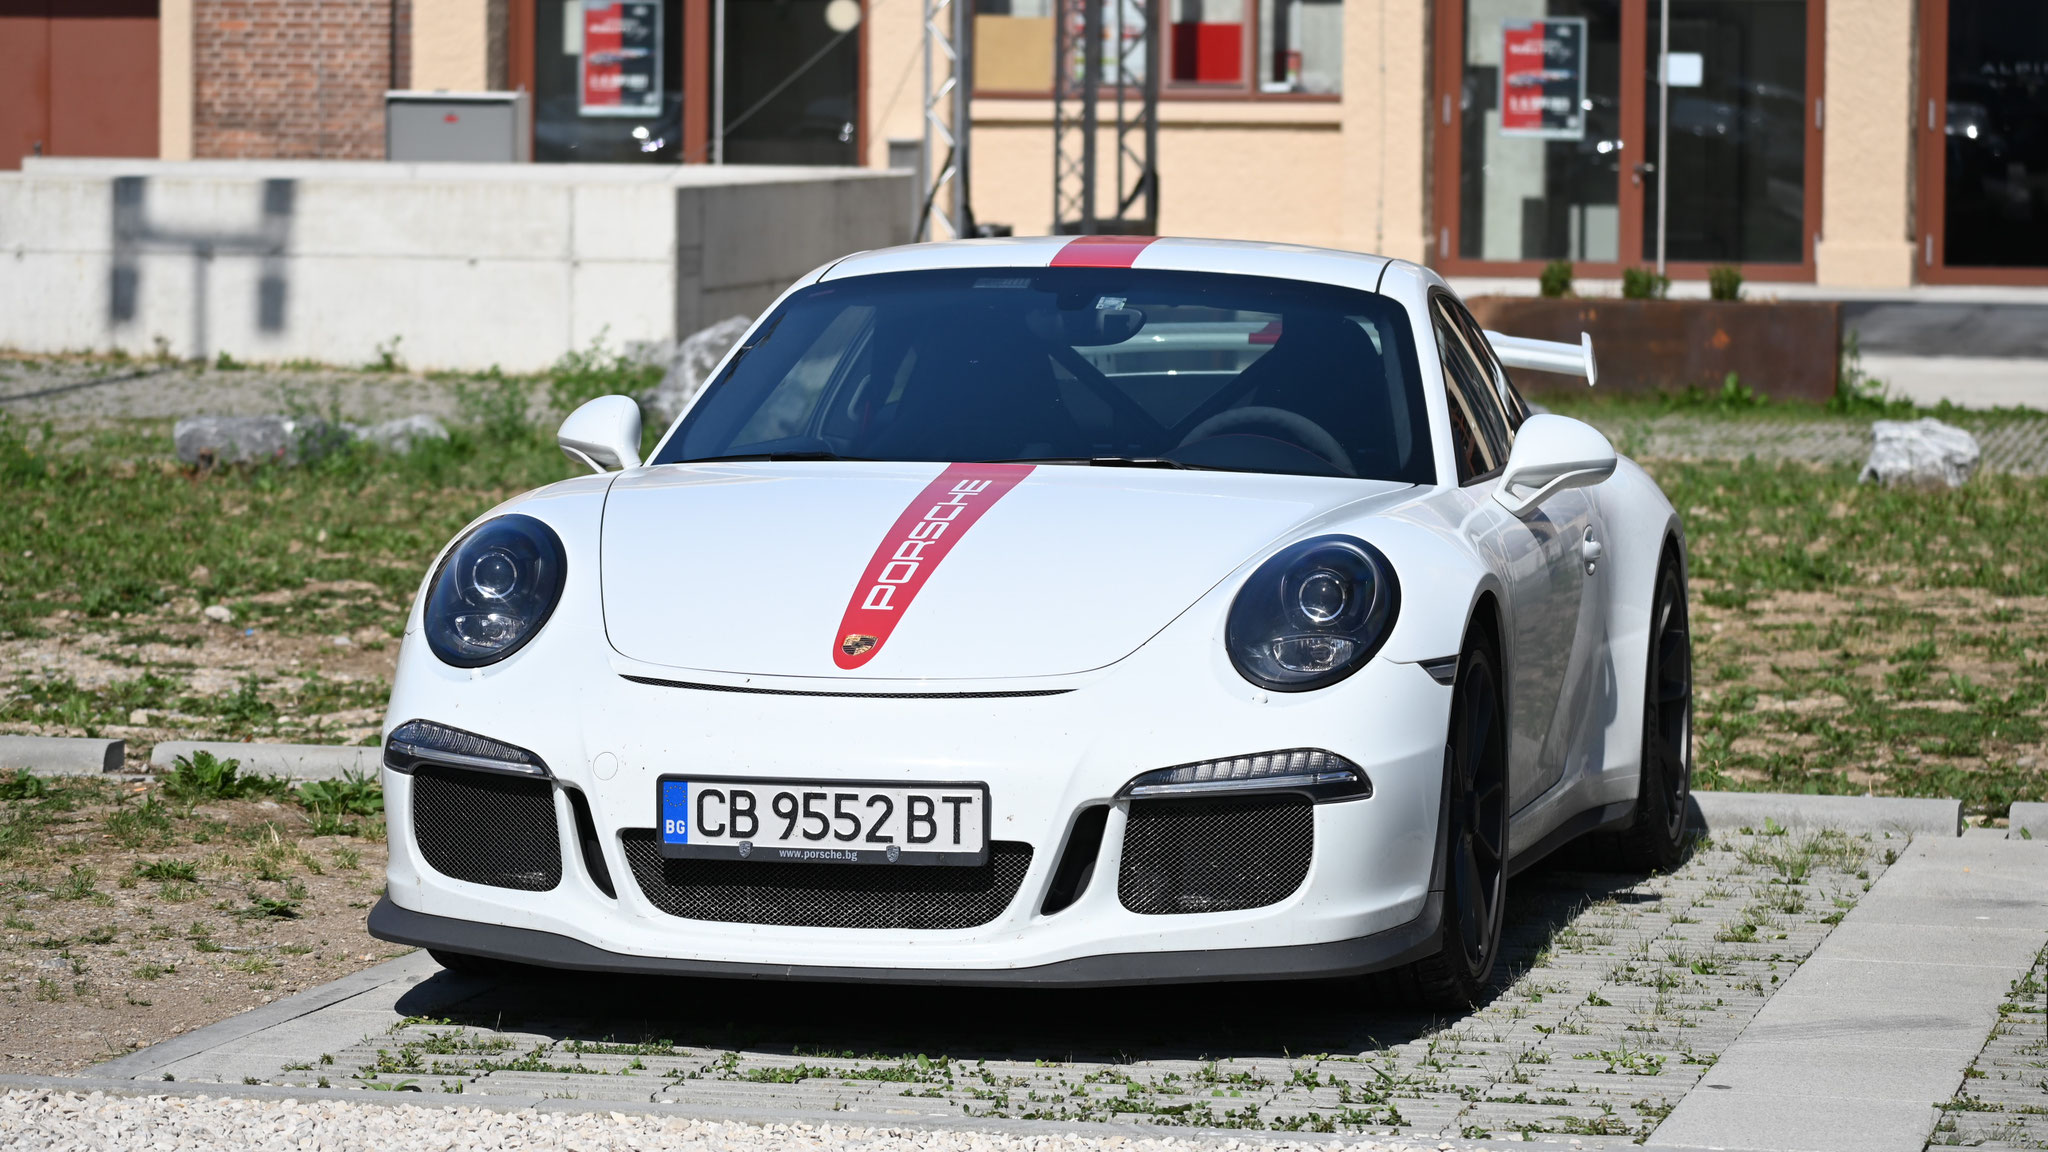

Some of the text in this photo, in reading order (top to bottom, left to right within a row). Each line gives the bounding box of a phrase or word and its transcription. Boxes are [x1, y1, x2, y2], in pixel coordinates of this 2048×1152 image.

[861, 479, 993, 611] PORSCHE
[665, 819, 686, 835] BG
[696, 788, 973, 845] CB 9552 BT
[779, 849, 858, 862] www.porsche.bg
